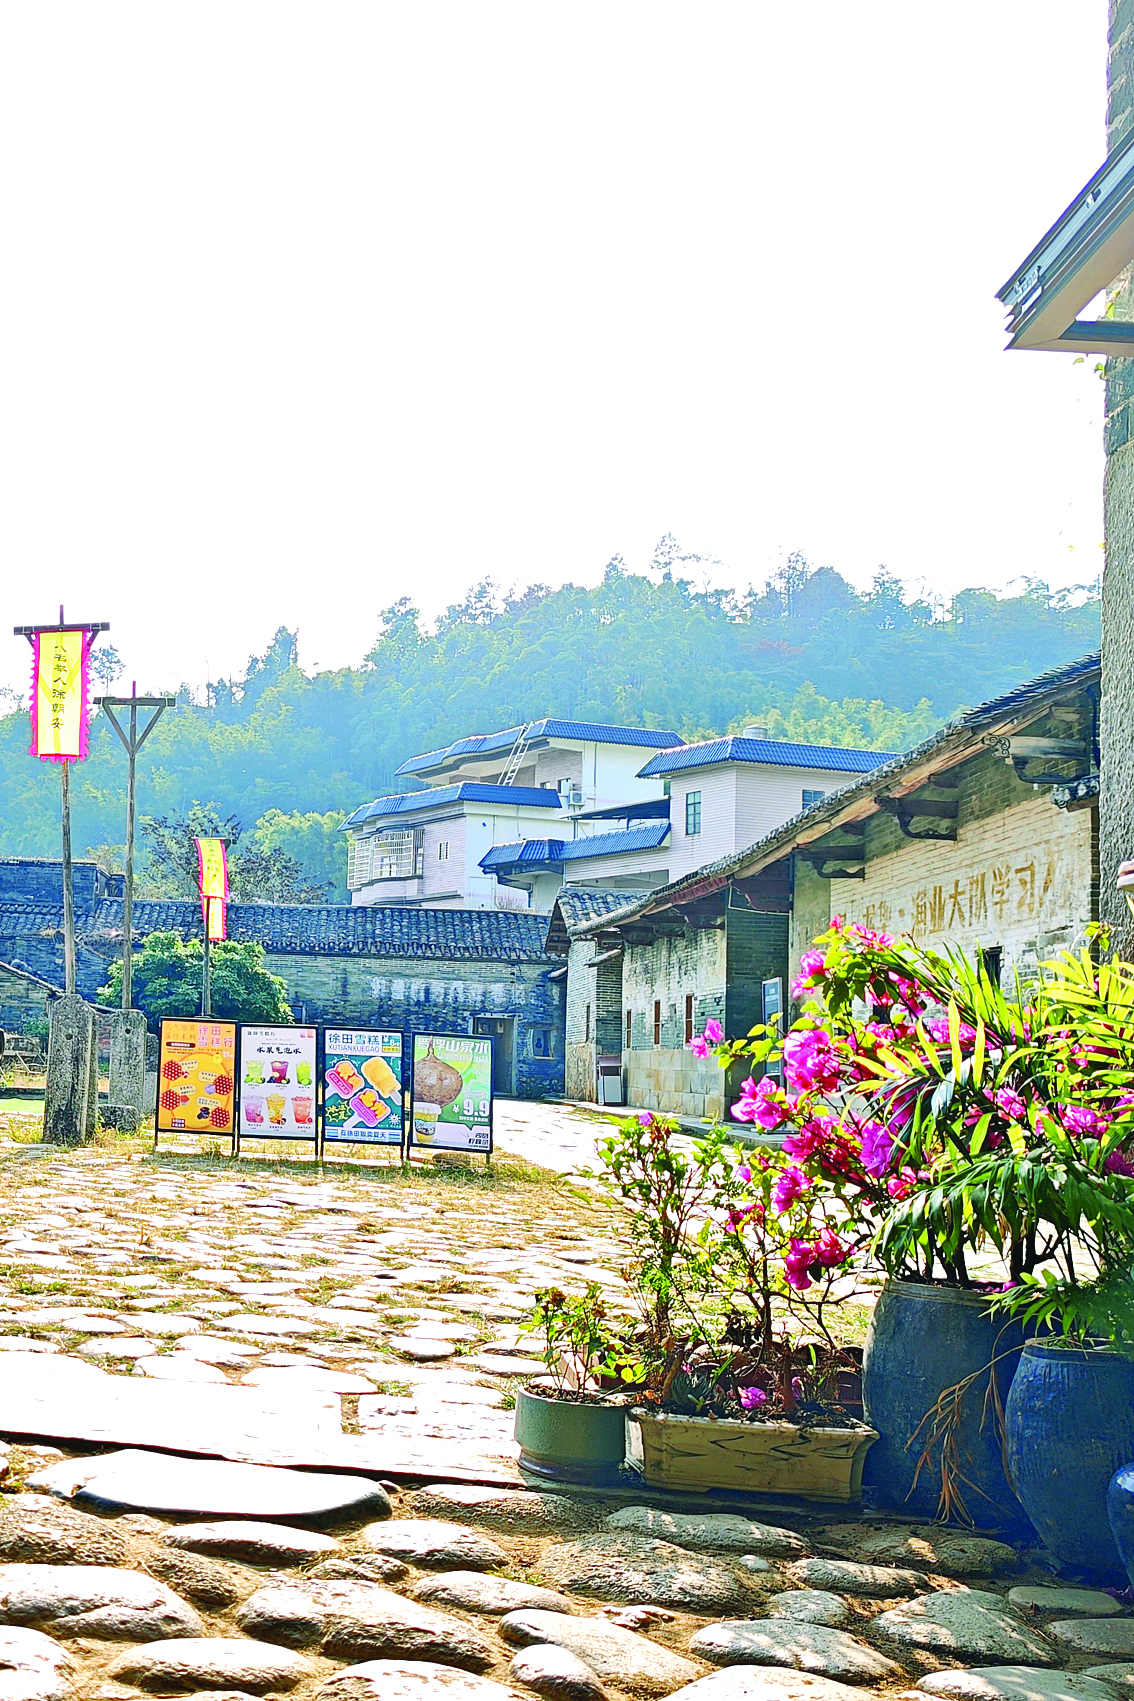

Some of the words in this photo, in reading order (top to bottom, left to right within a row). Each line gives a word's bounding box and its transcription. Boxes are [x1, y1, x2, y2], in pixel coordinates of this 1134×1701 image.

[328, 1033, 380, 1046] 徐田雪糕
[327, 1044, 380, 1053] XUTIANXUEGAO
